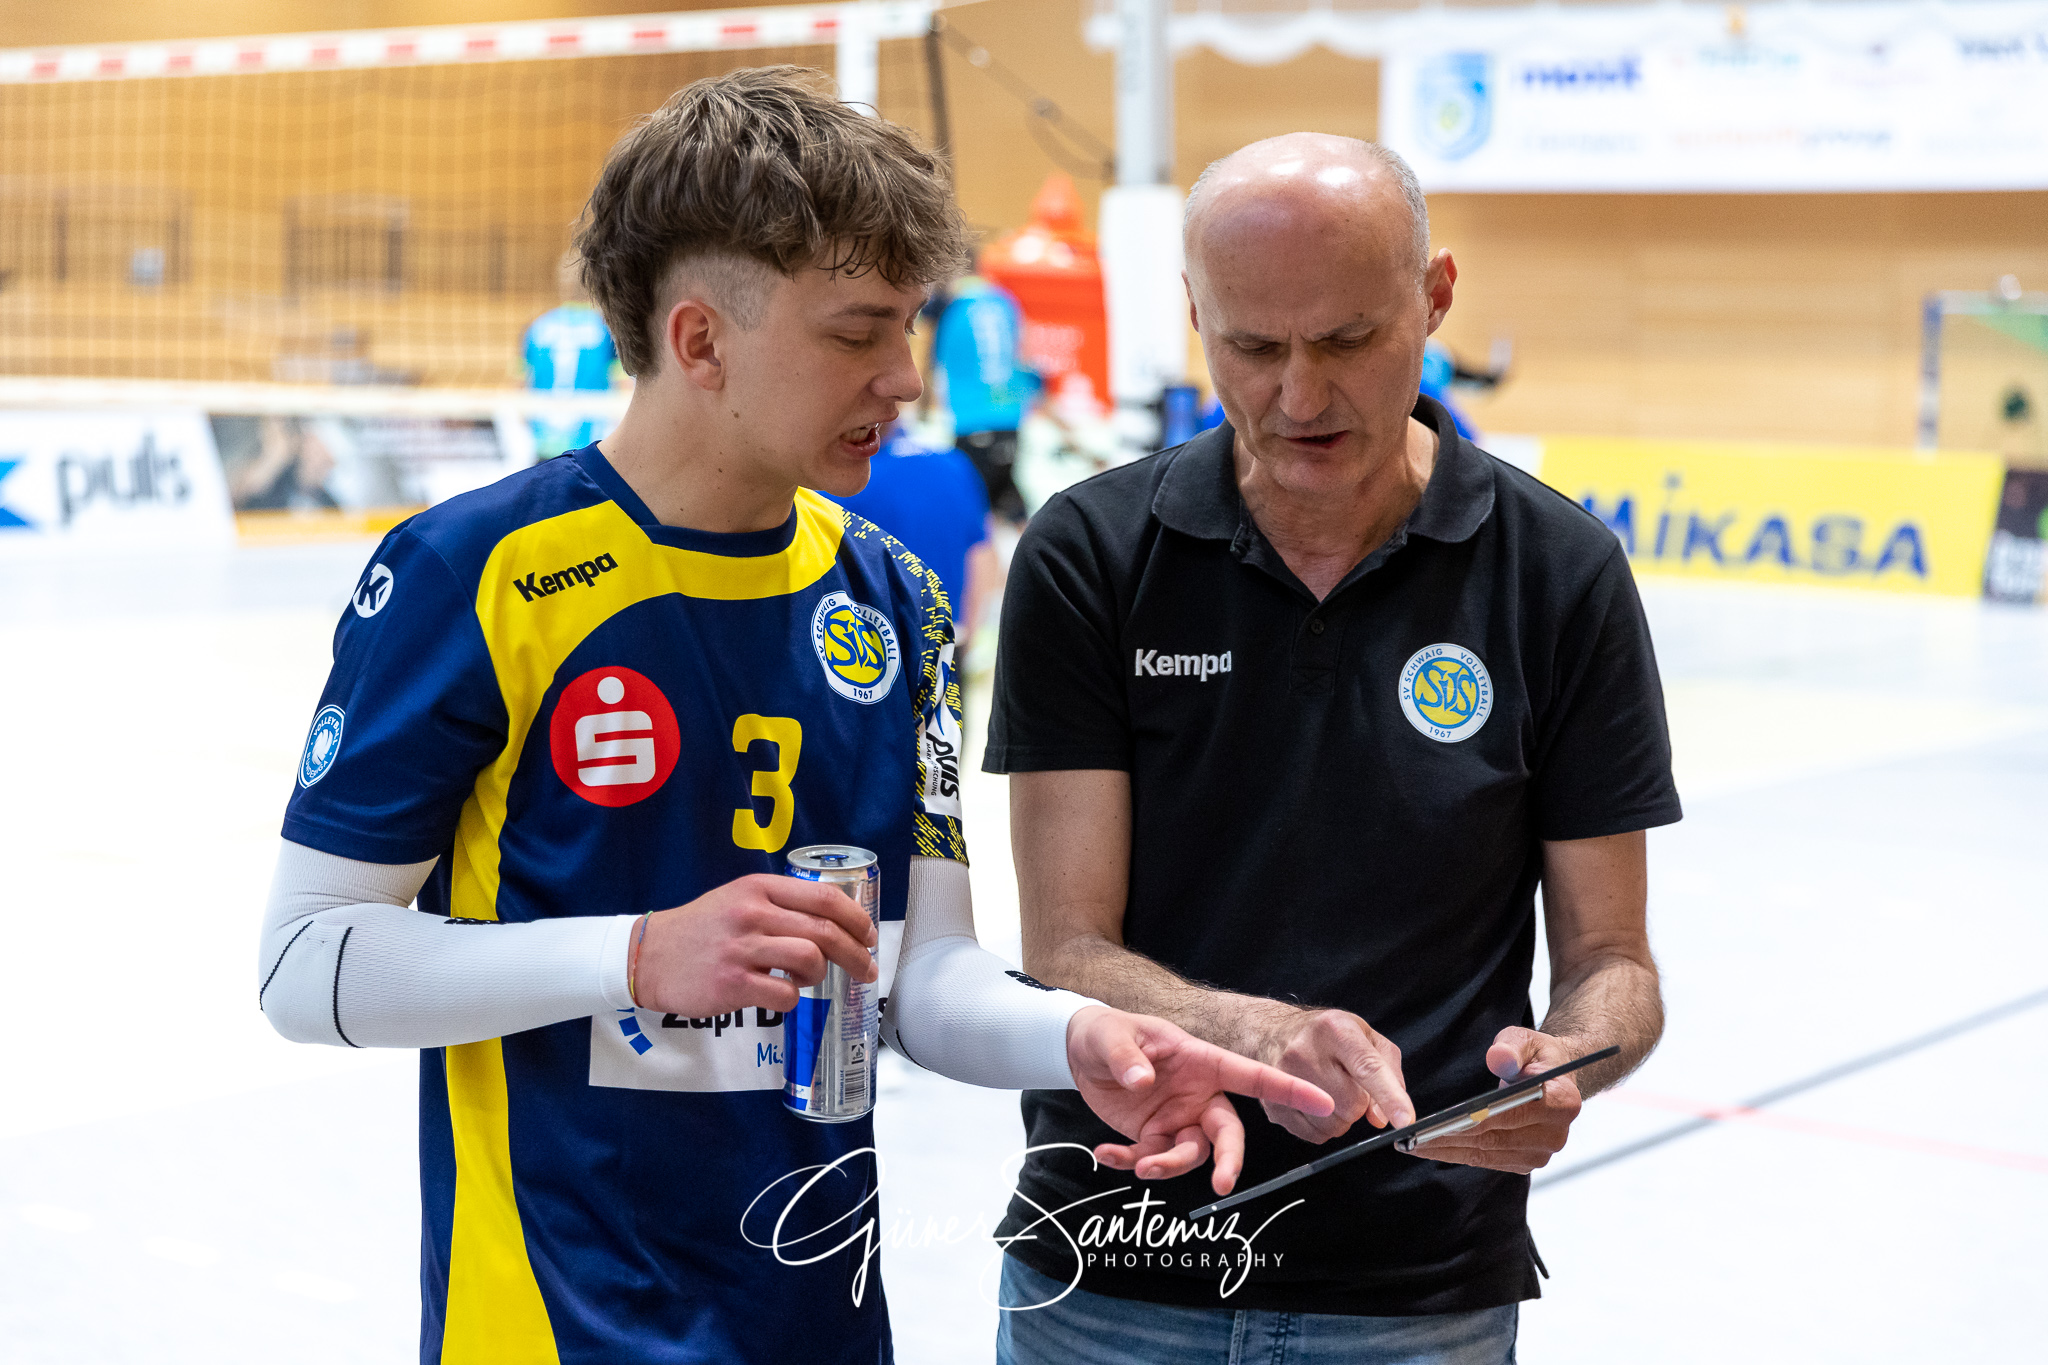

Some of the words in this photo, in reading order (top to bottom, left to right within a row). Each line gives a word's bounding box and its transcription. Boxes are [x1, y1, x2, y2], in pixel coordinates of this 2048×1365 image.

[513, 552, 619, 603] Kempa
[1405, 648, 1443, 683] SCHWAIG
[853, 688, 873, 700] 1967
[1403, 686, 1411, 700] SV
[1460, 652, 1489, 718] VOLLEYBALL
[1429, 726, 1452, 739] 1967
[732, 713, 803, 854] 3
